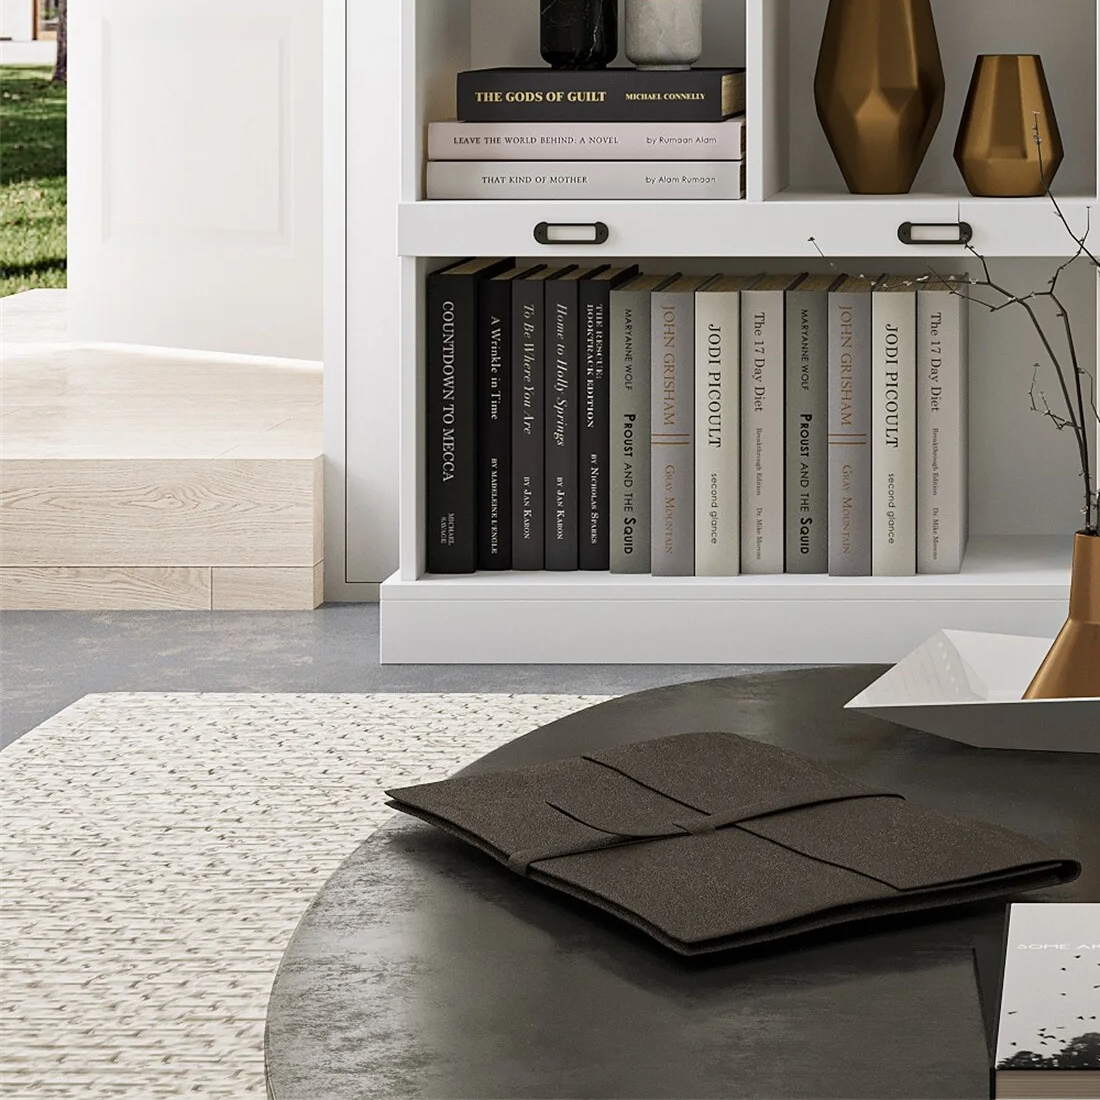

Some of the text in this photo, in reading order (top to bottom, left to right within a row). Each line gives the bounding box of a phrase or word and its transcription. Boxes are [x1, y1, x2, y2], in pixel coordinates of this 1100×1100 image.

[475, 92, 606, 102] THE GODS OF GUILT
[659, 136, 693, 144] Rumaan
[443, 301, 454, 481] COUNTDOWN TO MECCA
[491, 316, 501, 419] A Wrinkle in Time
[553, 304, 568, 446] Home to Holly Springs
[661, 305, 675, 426] JOHN GRISHAM
[708, 324, 721, 448] JODI PICOULT
[752, 312, 765, 411] The 17 Day Diet
[710, 511, 718, 544] glance
